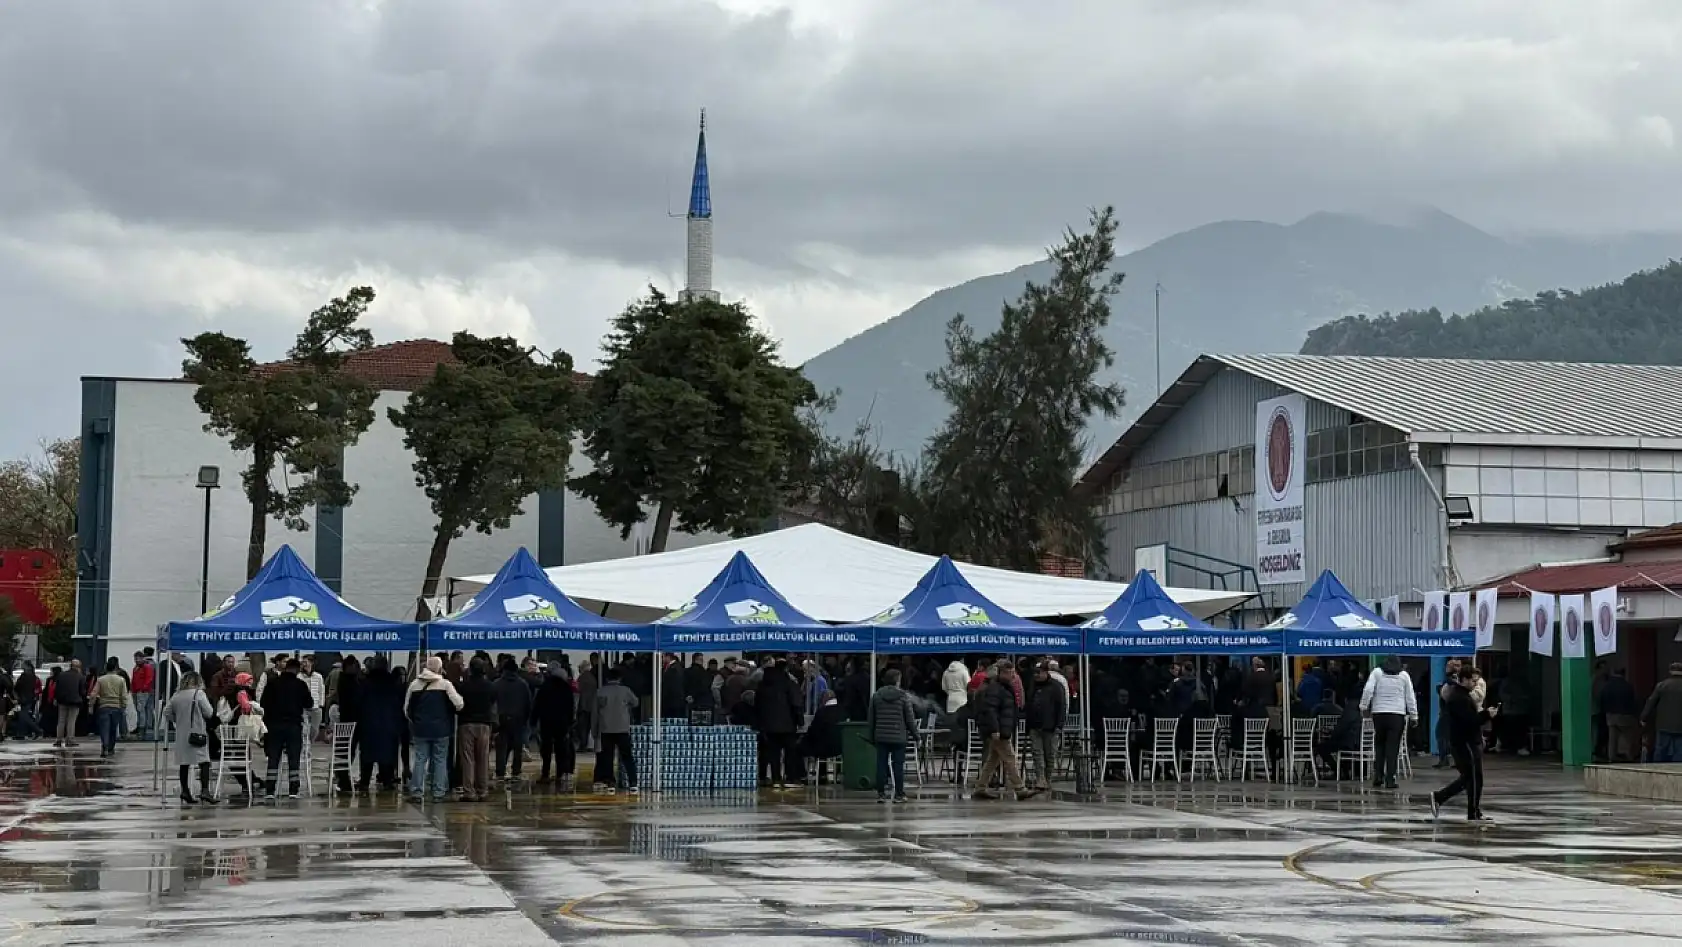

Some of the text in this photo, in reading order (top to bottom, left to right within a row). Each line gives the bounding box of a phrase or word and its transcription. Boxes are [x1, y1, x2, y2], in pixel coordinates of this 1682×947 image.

[186, 630, 401, 642] FETHİYE BELEDİYESİ KÜLTÜR İŞLERİ MÜD.
[443, 630, 640, 642] FETHİYE BELEDİYESİ KÜLTÜR İŞLERİ MÜD.
[674, 632, 858, 644] FETHİYE BELEDİYESİ KÜLTÜR İŞLERİ MÜD.
[890, 636, 926, 645] FETHİYE
[929, 635, 979, 644] BELEDİYESİ
[981, 635, 1016, 644] KÜLTÜR
[1018, 636, 1045, 646] İŞLERİ
[1099, 636, 1134, 645] FETHİYE
[1136, 635, 1184, 645] BELEDİYESİ
[1186, 635, 1220, 645] KÜLTÜR
[1221, 636, 1247, 646] İŞLERİ
[1299, 638, 1332, 647] FETHİYE
[1335, 637, 1381, 646] BELEDİYESİ
[1383, 638, 1415, 647] KÜLTÜR
[1417, 638, 1442, 648] İŞLERİ
